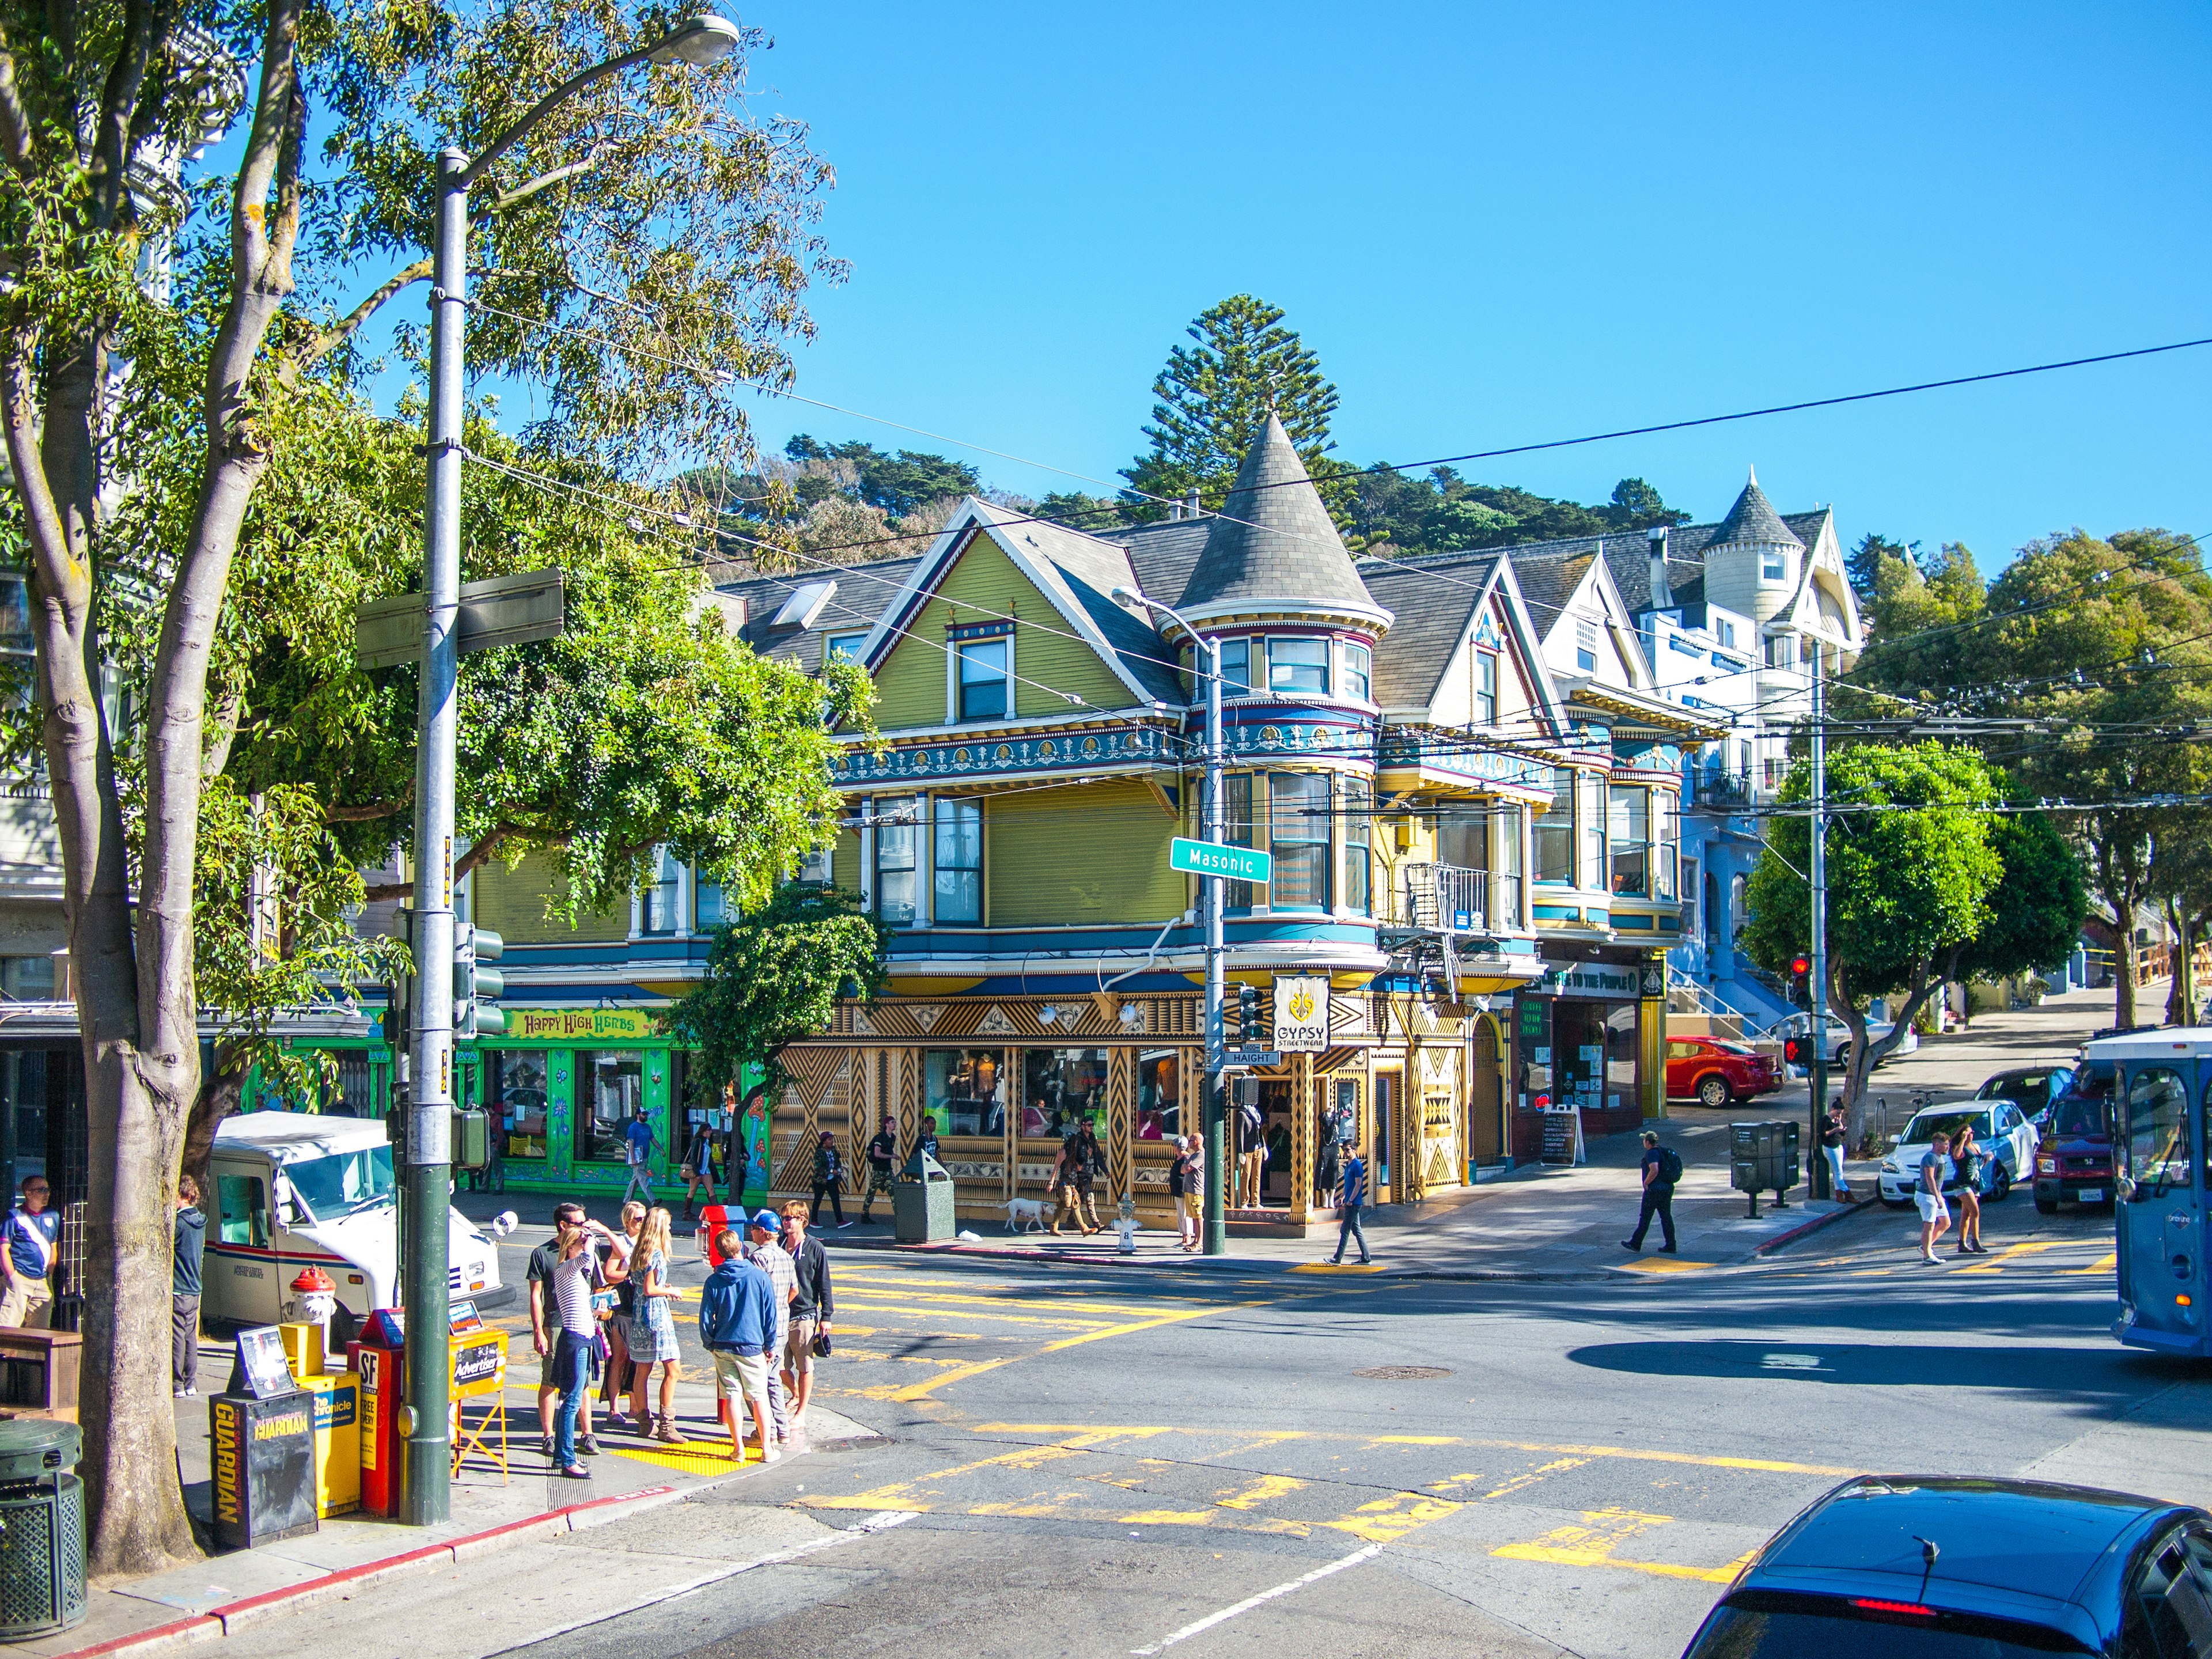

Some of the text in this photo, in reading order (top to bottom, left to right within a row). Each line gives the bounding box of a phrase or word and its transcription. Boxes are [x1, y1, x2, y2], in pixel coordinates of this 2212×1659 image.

[1190, 848, 1253, 873] Masonic
[1572, 972, 1583, 987] TO
[1584, 973, 1599, 988] THE
[594, 1015, 635, 1033] HERBS
[1278, 1027, 1324, 1039] GYPSY
[1234, 1054, 1270, 1062] HAIGHT
[361, 1353, 377, 1385] SF
[454, 1356, 496, 1377] Advertiser
[255, 1414, 309, 1441] GUARDIAN
[215, 1403, 238, 1524] GUARDIAN
